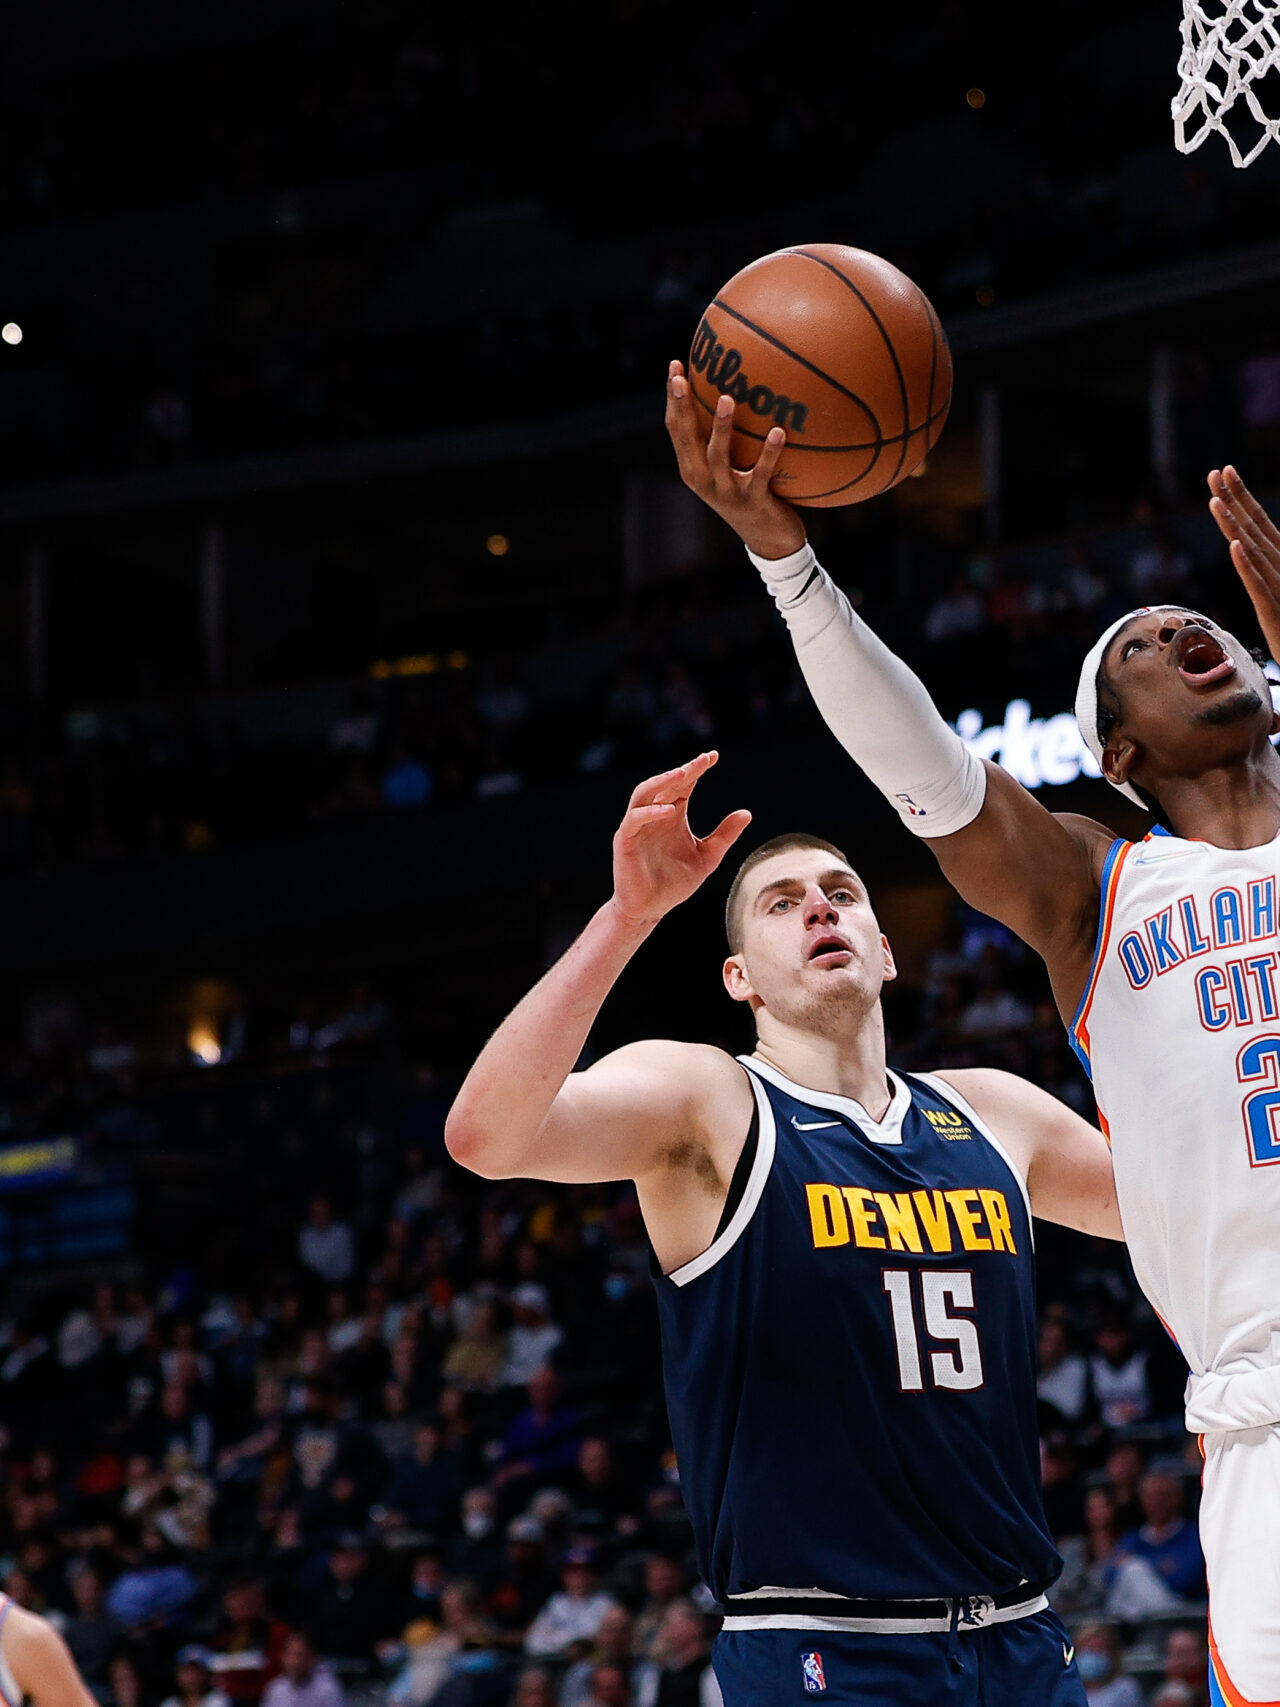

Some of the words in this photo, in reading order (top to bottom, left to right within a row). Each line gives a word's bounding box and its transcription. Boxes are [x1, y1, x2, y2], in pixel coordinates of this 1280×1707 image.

[692, 317, 808, 434] Wilson
[920, 1109, 962, 1126] WU
[932, 1126, 972, 1134] Western
[943, 1133, 972, 1141] Union
[804, 1182, 1017, 1255] DENVER
[881, 1268, 985, 1392] 15
